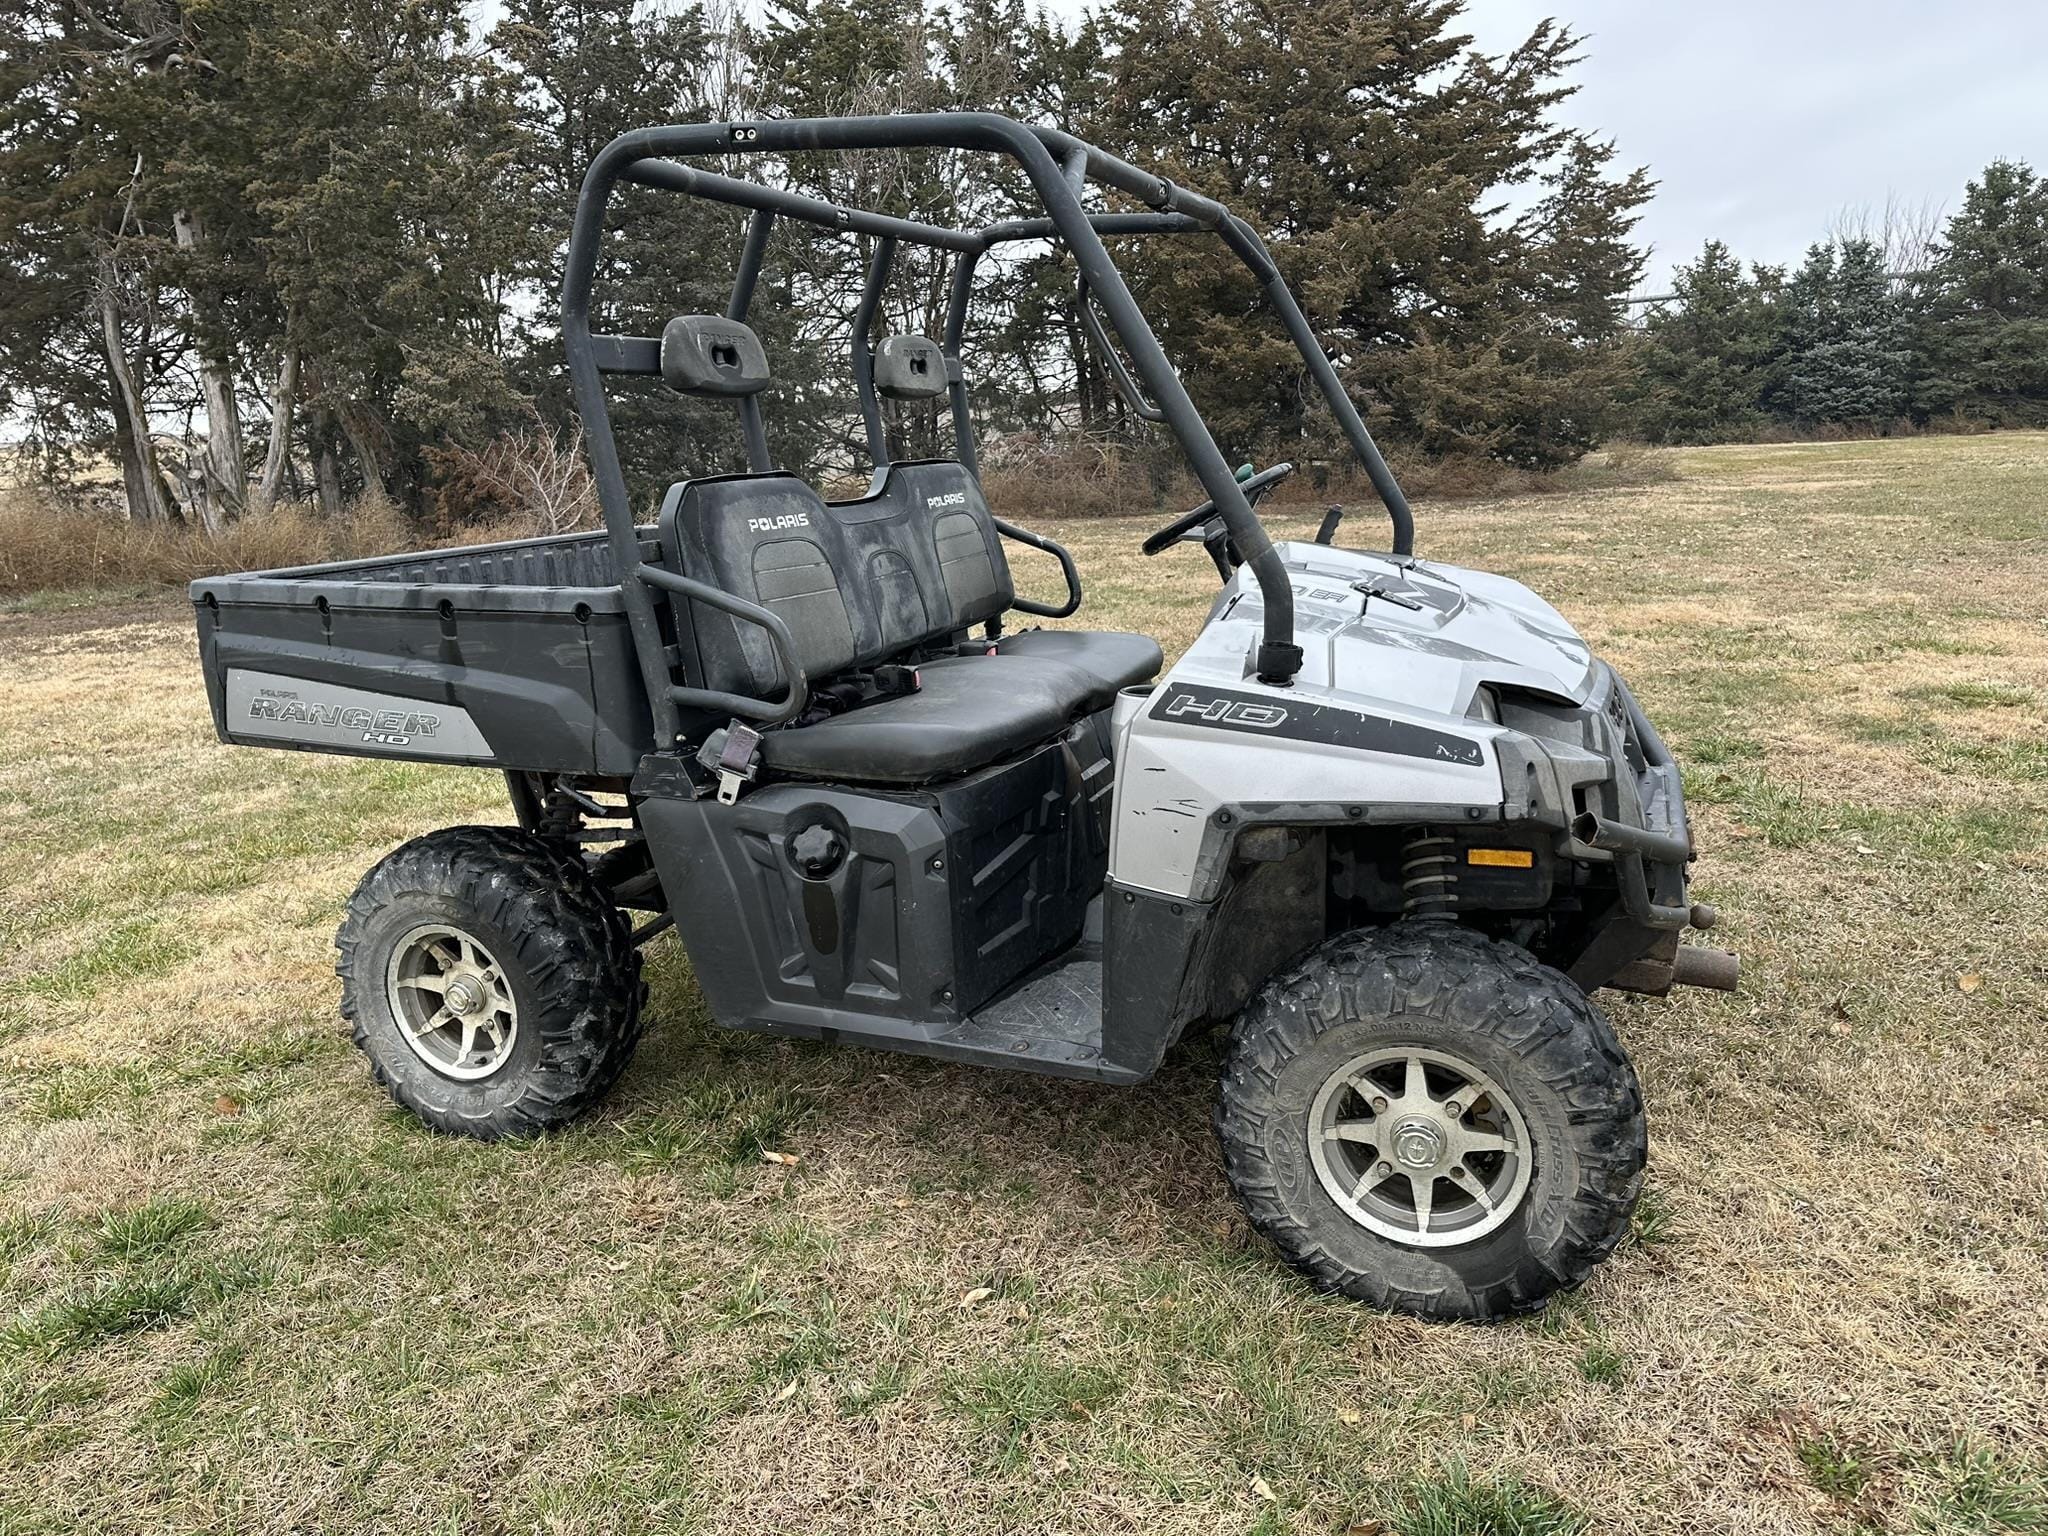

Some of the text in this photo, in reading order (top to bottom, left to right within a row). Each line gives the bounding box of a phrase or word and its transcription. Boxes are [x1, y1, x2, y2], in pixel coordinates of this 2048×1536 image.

[927, 492, 965, 510] POLARIS
[747, 512, 809, 533] POLARIS
[248, 696, 441, 738] RANGER
[1165, 693, 1288, 728] HD
[361, 731, 411, 746] HD
